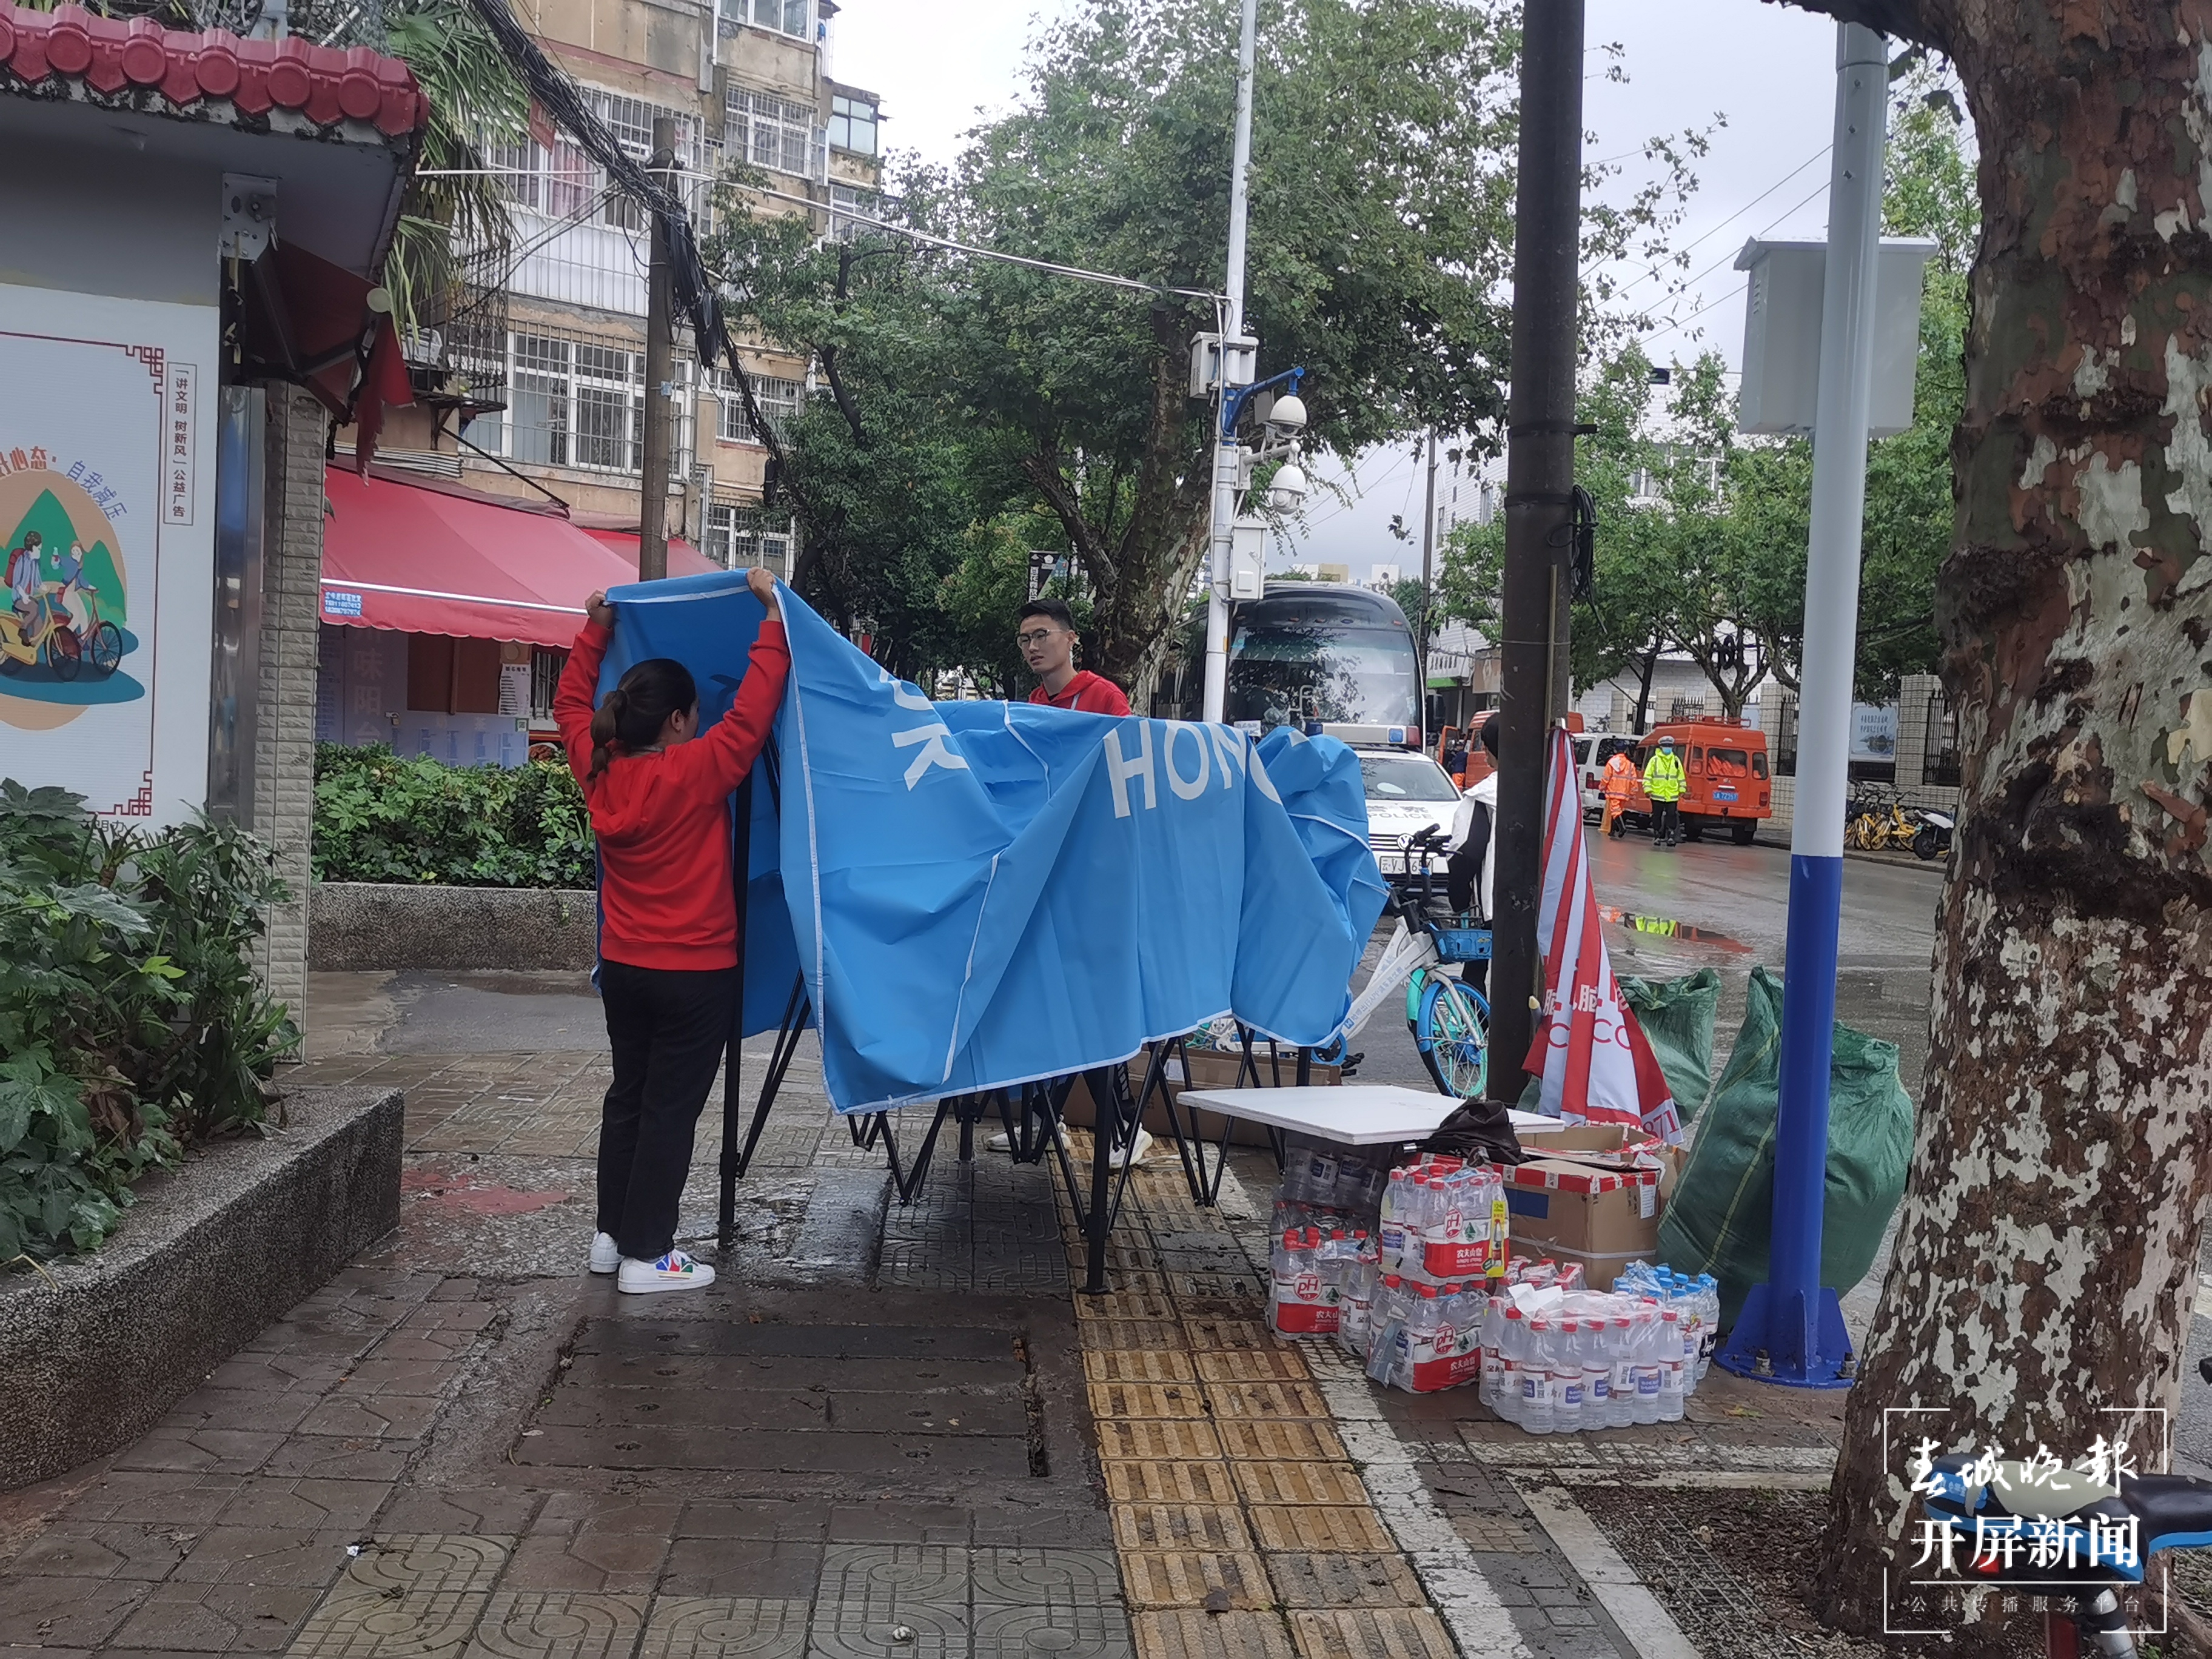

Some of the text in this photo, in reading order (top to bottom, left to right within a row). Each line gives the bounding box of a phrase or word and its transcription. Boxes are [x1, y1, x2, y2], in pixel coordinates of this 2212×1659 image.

[66, 460, 127, 521] 自我减压
[1298, 1279, 1318, 1294] pH
[1436, 1329, 1453, 1347] pH
